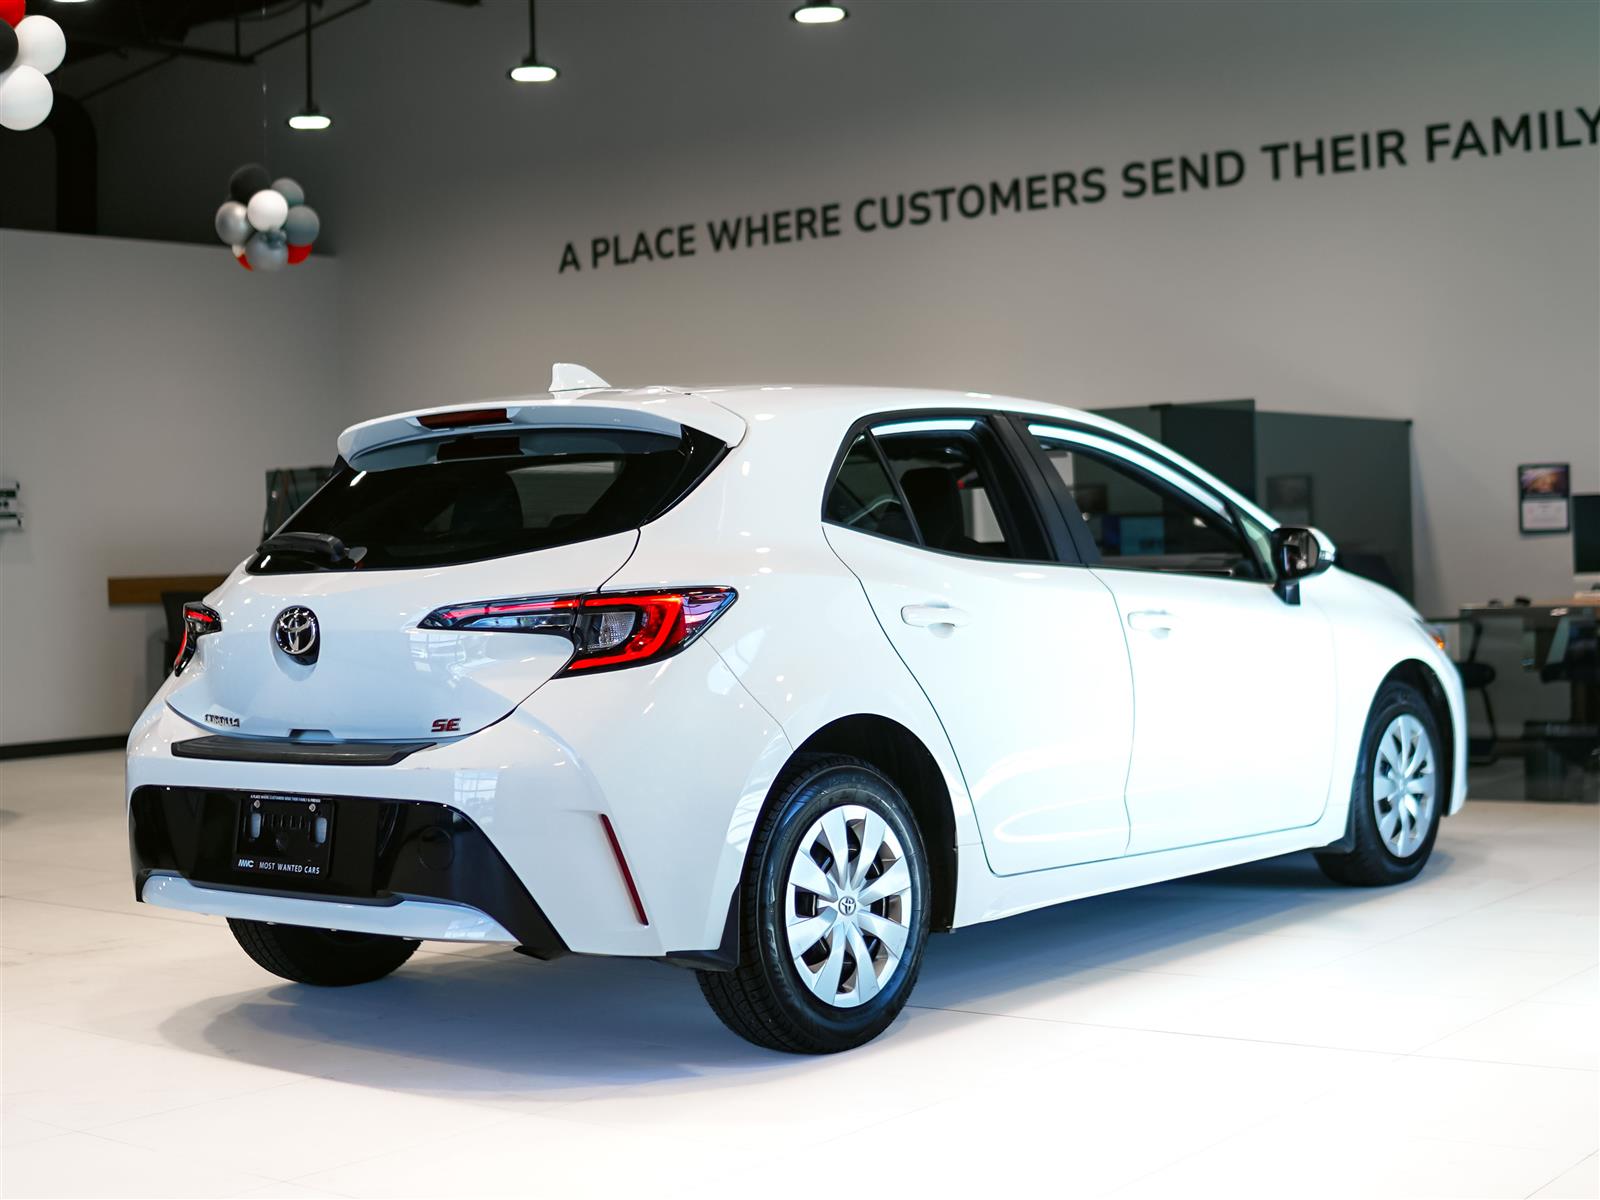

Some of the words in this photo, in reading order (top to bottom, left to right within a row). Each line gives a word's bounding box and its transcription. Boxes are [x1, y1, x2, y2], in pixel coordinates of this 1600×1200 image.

[558, 241, 581, 274] A
[591, 224, 696, 269] PLACE
[707, 203, 841, 253] WHERE
[854, 166, 1107, 233] CUSTOMERS
[1121, 149, 1246, 199] SEND
[1260, 129, 1408, 181] THEIR
[1425, 105, 1600, 164] FAMILY
[431, 717, 461, 732] SE
[259, 861, 275, 870] MOST
[277, 863, 303, 873] WANTED
[304, 866, 320, 875] CARS
